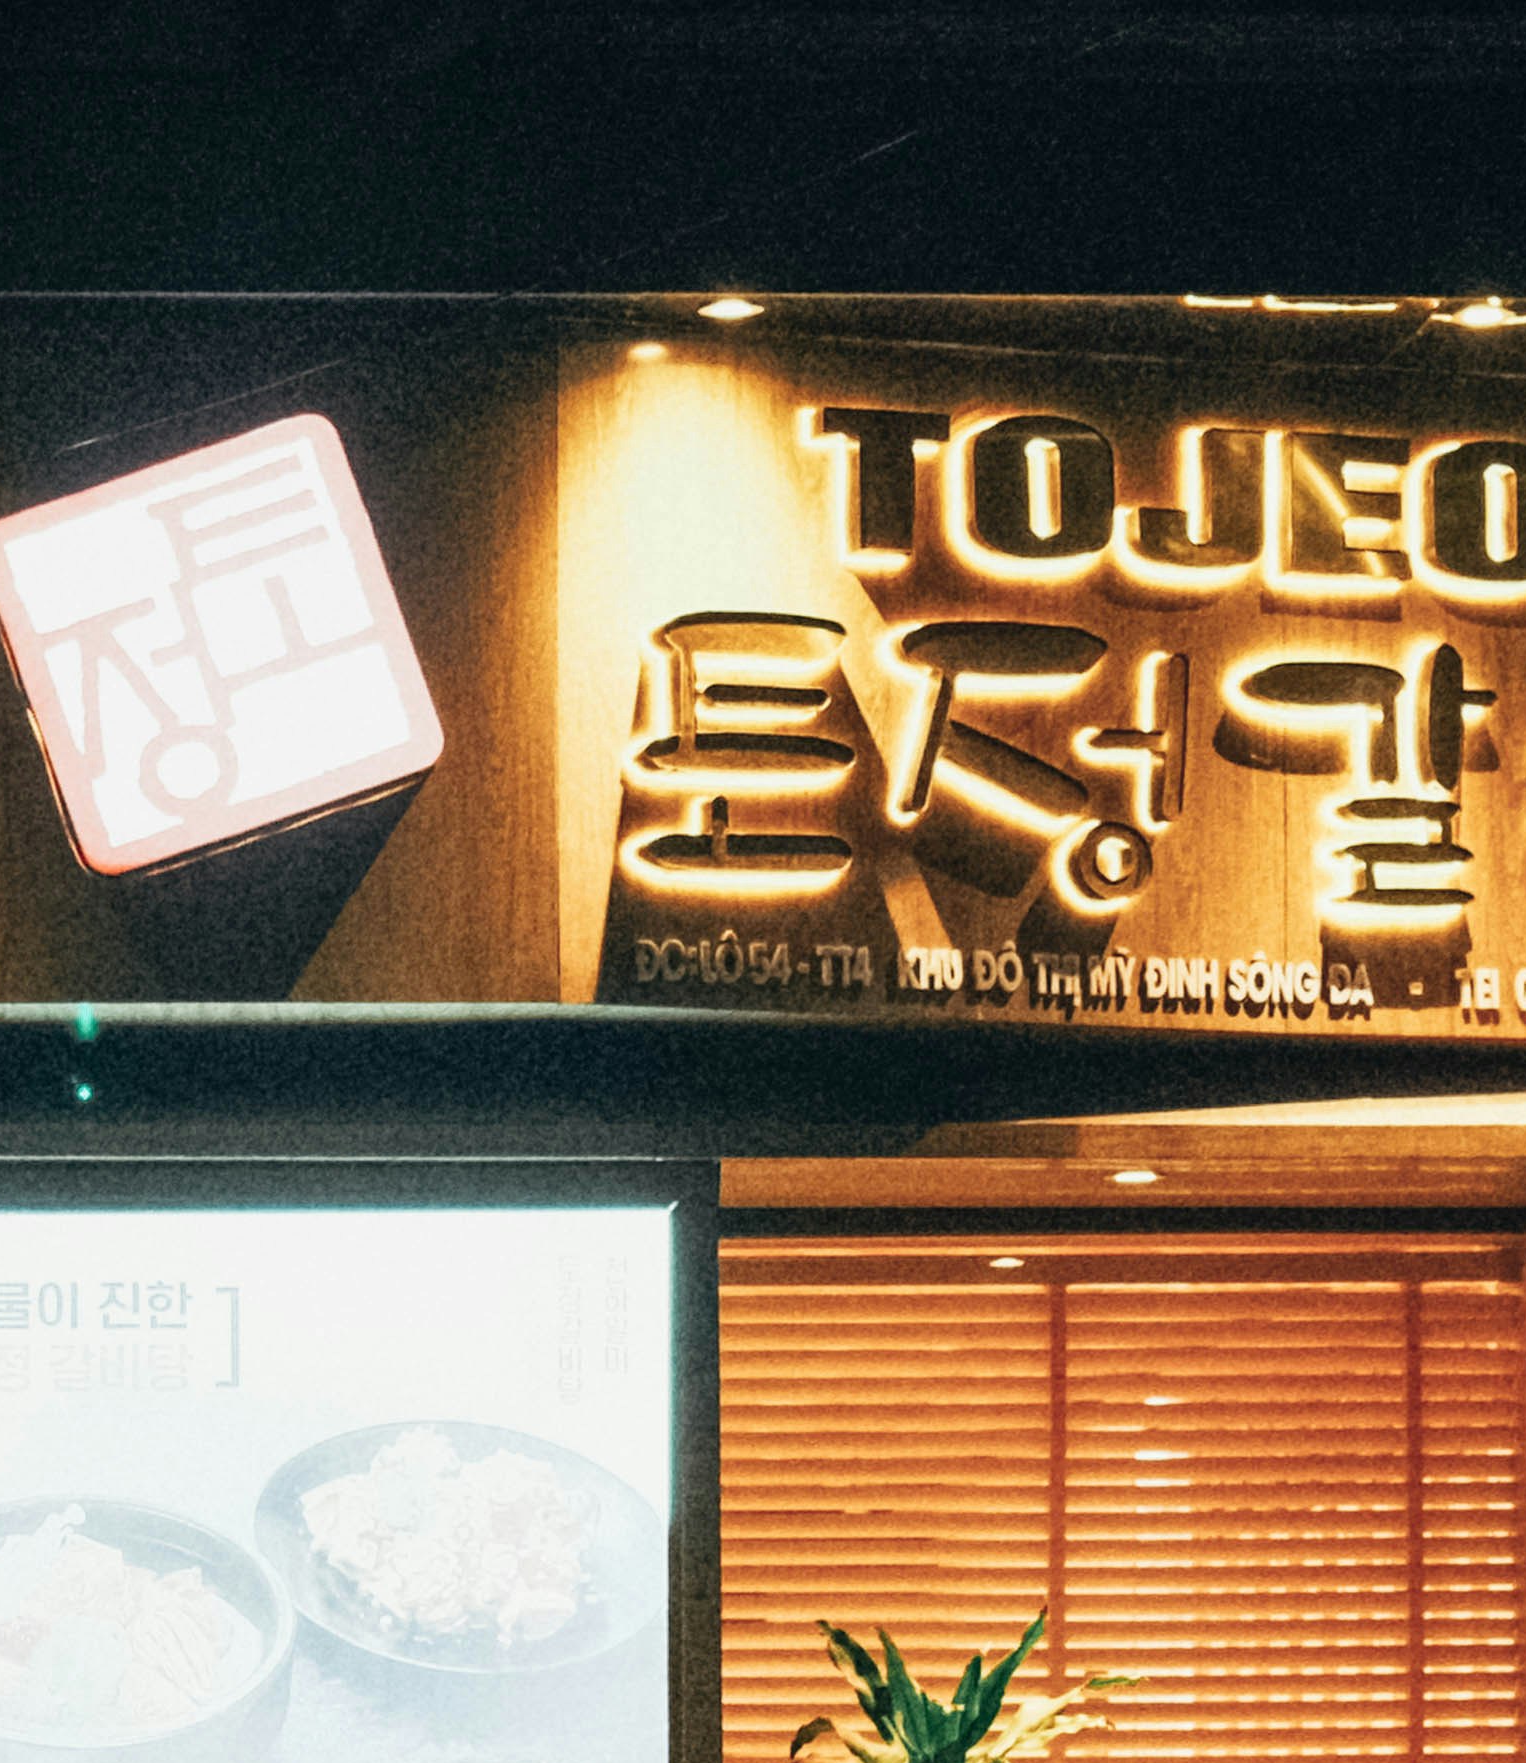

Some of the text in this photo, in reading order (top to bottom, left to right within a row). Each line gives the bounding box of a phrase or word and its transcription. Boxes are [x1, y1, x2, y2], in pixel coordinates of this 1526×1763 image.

[898, 947, 964, 992] KHU
[1227, 950, 1321, 1005] SÔNG
[97, 1280, 194, 1330] 진한
[49, 1342, 195, 1393] 갈비탕
